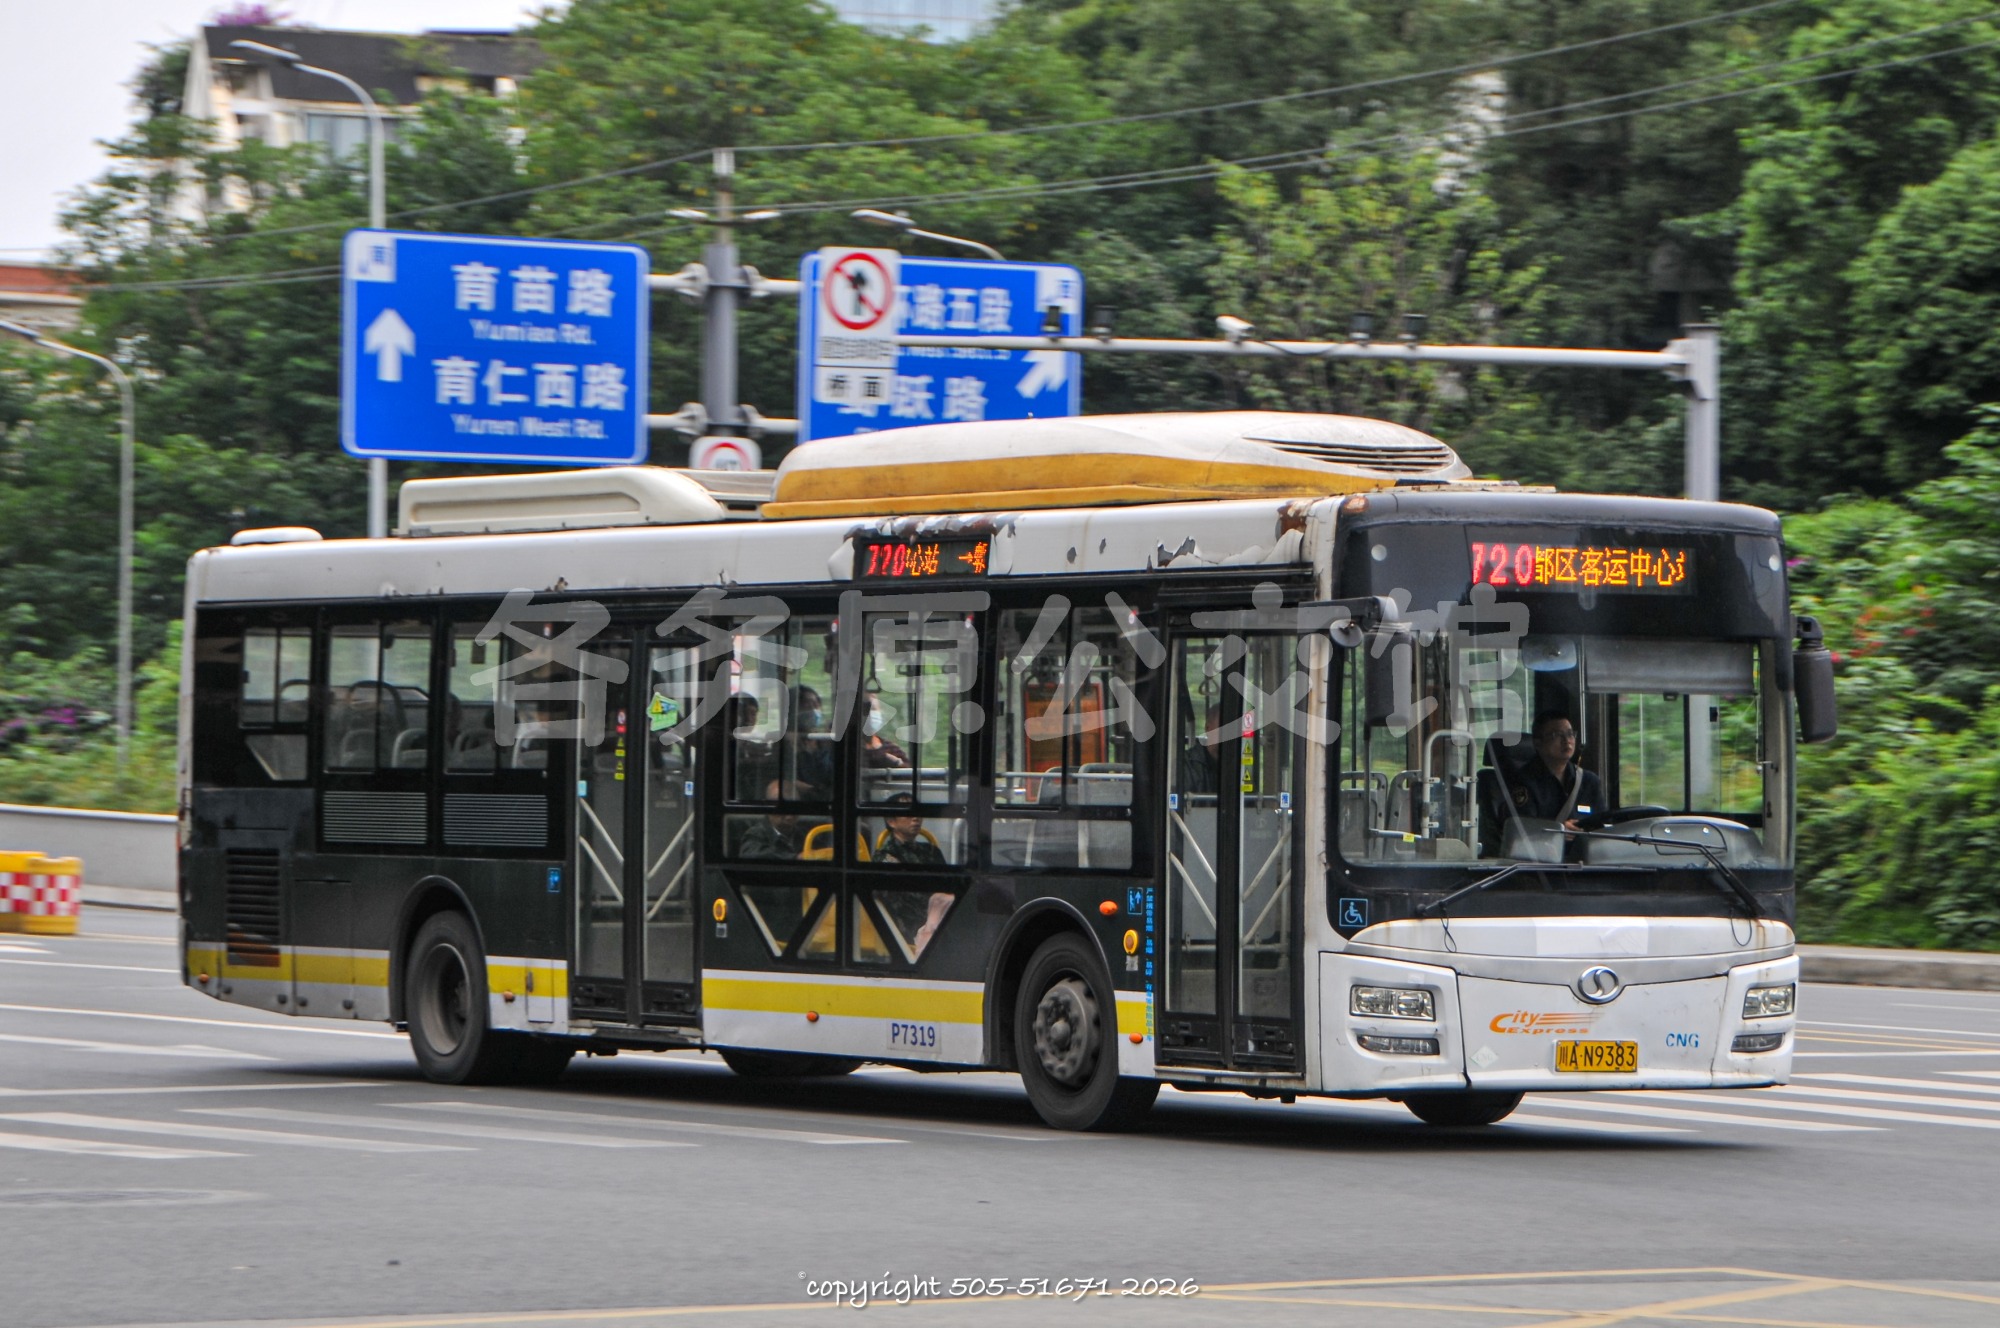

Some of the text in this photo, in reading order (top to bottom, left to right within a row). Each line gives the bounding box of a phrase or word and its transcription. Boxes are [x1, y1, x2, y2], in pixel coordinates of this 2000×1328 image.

[450, 261, 616, 317] 育苗路
[559, 323, 597, 345] Rd.
[431, 355, 629, 411] 育仁西路
[837, 375, 989, 421] 跃路
[573, 418, 609, 439] Rd.
[1472, 542, 1534, 585] 720
[1489, 1010, 1540, 1034] City
[1505, 1027, 1590, 1036] Express
[891, 1023, 936, 1047] P7319
[1665, 1033, 1700, 1049] CNG
[1558, 1045, 1636, 1068] 川A·N9383
